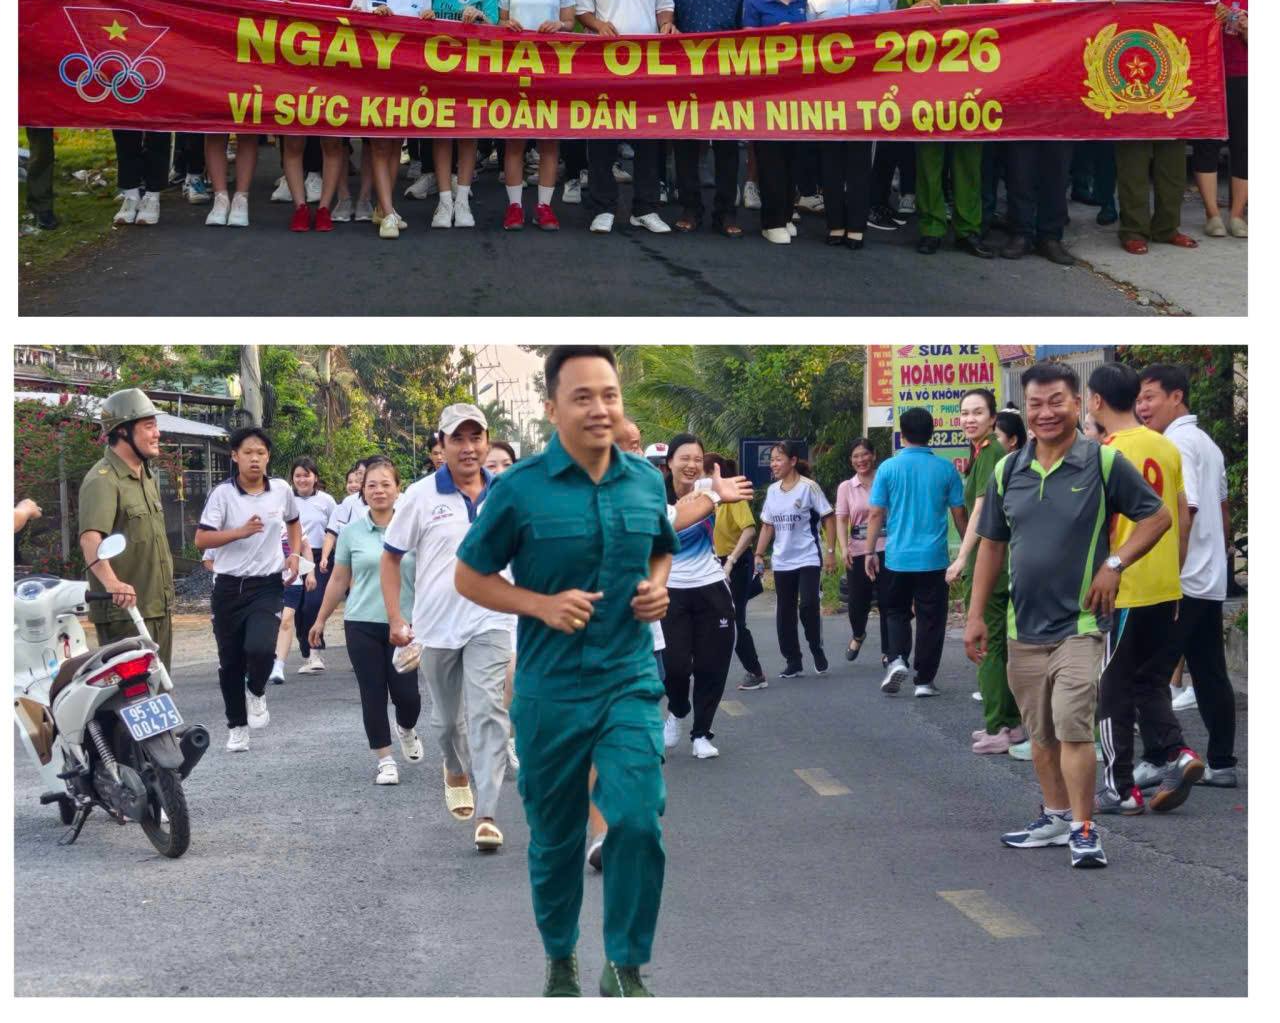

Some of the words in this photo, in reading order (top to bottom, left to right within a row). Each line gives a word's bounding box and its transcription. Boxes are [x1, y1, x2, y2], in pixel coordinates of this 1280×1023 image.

[236, 16, 406, 70] NGÀY
[424, 34, 585, 87] CHẠY
[603, 32, 856, 77] OLYMPIC
[873, 27, 1001, 73] 2026
[228, 84, 263, 124] VÌ
[274, 86, 349, 126] SỨC
[360, 85, 456, 128] KHỎE
[468, 92, 558, 130] TOÀN
[570, 92, 637, 130] DÂN
[667, 92, 699, 130] VÌ
[710, 100, 755, 130] AN
[766, 100, 847, 131] NINH
[856, 84, 901, 131] TỔ
[911, 88, 1003, 133] QUỐC
[900, 358, 956, 385] HOÀNG
[959, 355, 994, 384] KHẢI
